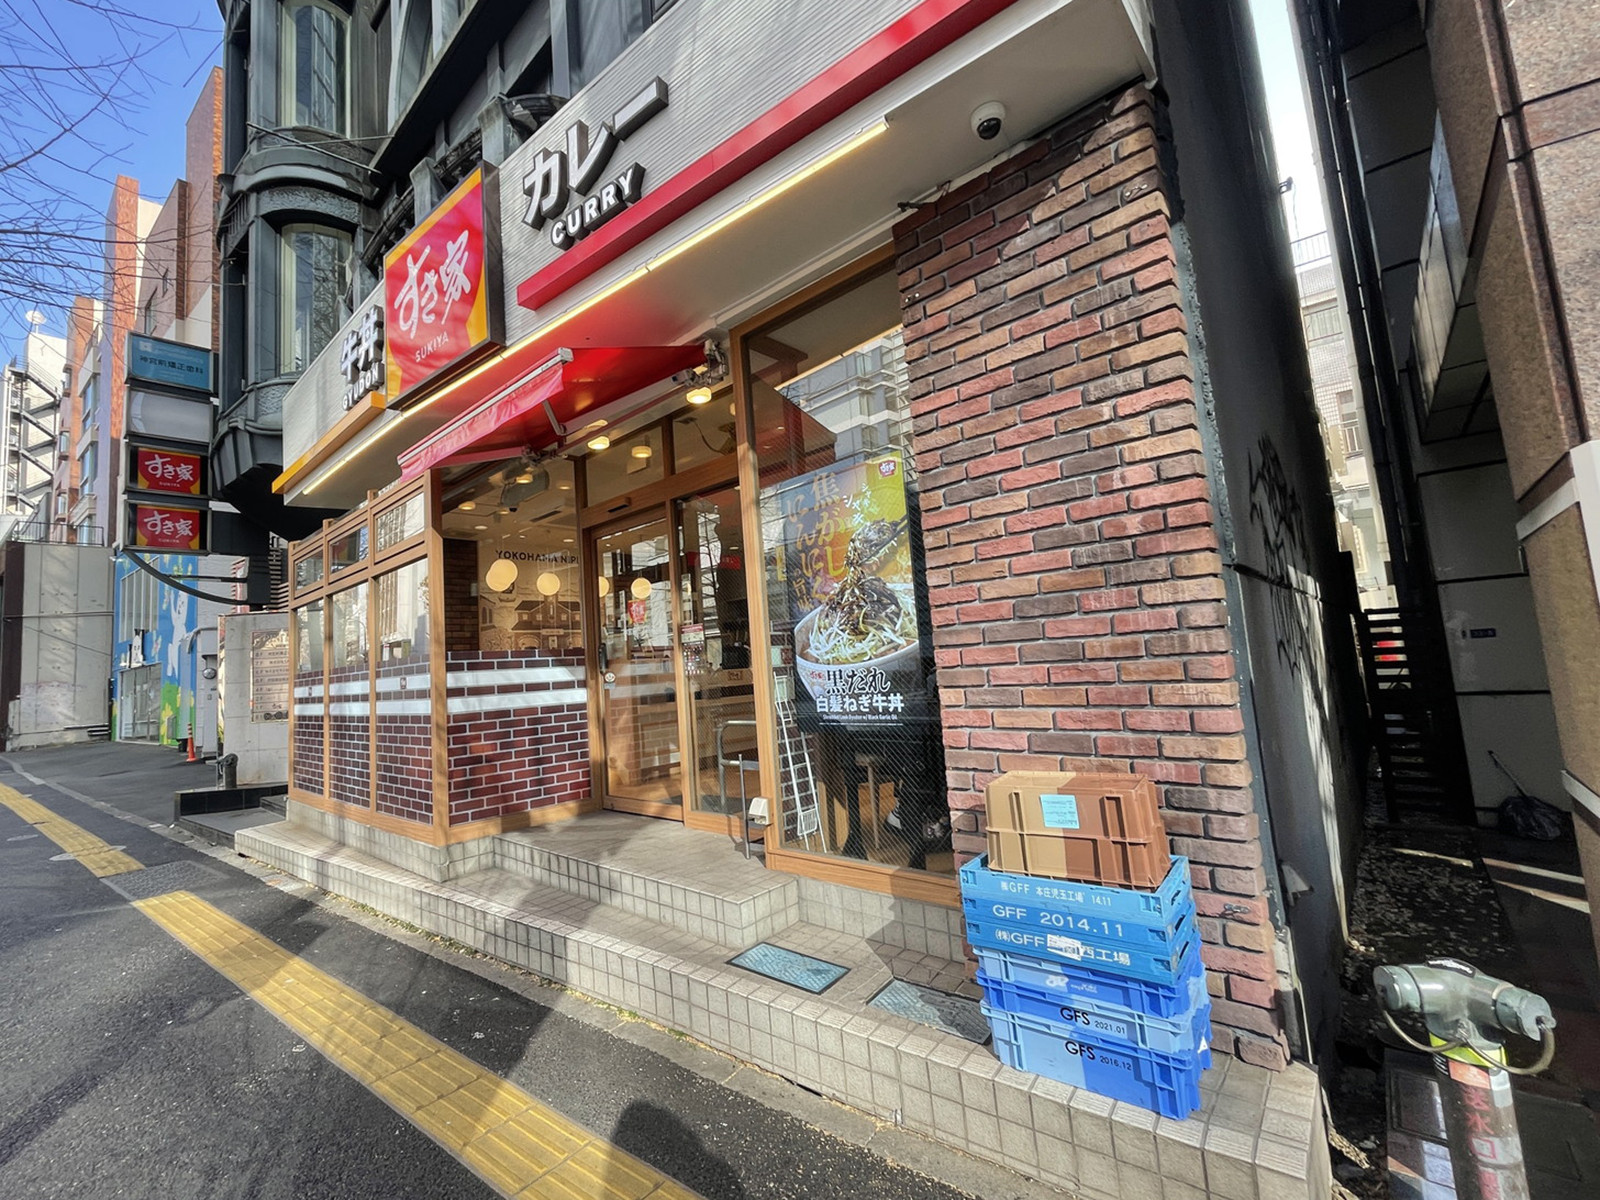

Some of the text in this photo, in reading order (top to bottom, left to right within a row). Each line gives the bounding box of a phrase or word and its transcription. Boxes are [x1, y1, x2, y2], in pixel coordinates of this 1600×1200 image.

[522, 78, 664, 228] カレー
[551, 165, 641, 246] CURRY
[394, 229, 471, 339] すき家
[341, 305, 382, 383] 牛丼
[415, 332, 449, 362] SUKIYA
[342, 361, 383, 410] GYUDON
[145, 454, 193, 482] すき家
[144, 510, 193, 538] すき家
[825, 667, 891, 695] 黒だれ
[816, 693, 904, 713] 白髪ねぎ牛丼
[992, 904, 1123, 937] GFF 2014.11
[1060, 1007, 1125, 1034] GFS 2021.01
[1065, 1040, 1096, 1061] GFS
